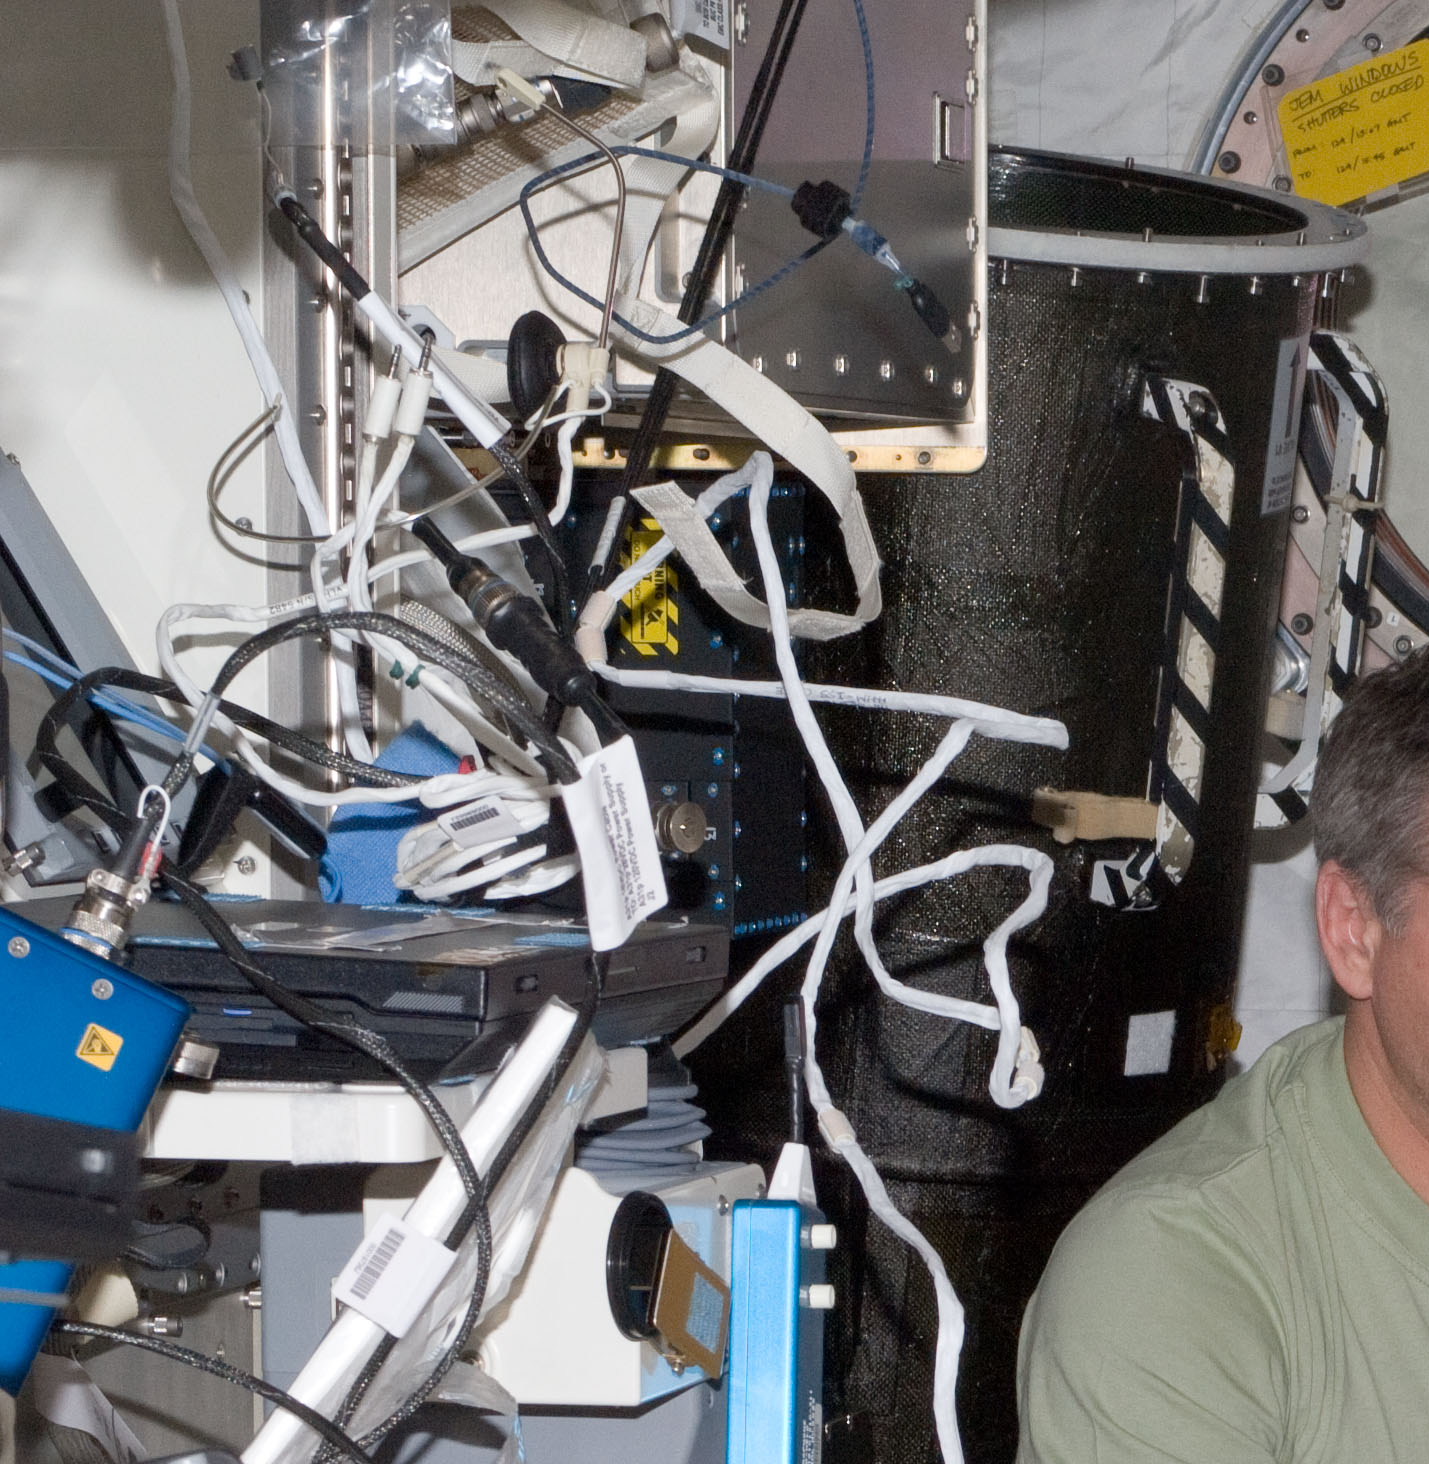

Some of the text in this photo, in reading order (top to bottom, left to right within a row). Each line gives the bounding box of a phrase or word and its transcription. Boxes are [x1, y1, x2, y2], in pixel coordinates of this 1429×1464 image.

[1289, 51, 1420, 112] JEM WINDOWS
[1370, 74, 1424, 103] CLOSED
[601, 775, 617, 809] Supply
[614, 782, 631, 817] Supply
